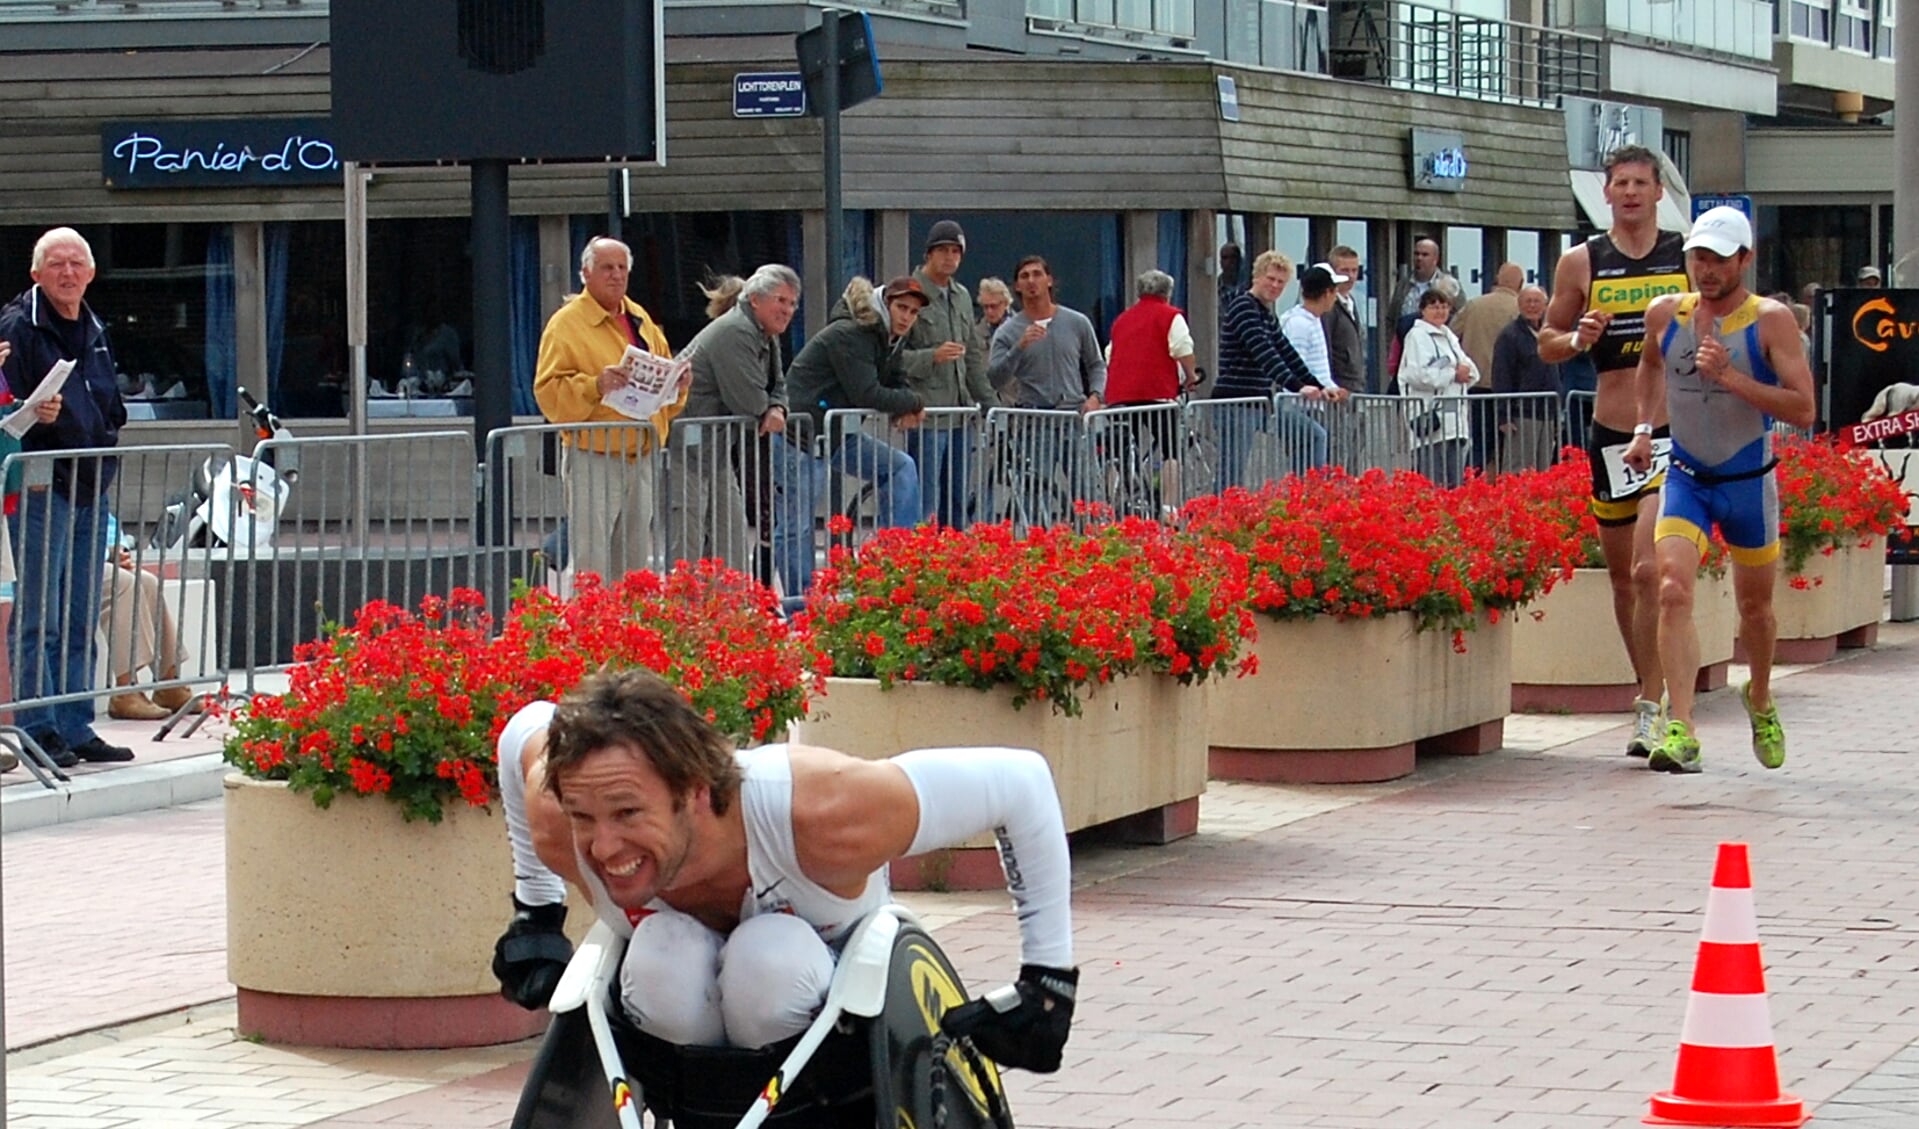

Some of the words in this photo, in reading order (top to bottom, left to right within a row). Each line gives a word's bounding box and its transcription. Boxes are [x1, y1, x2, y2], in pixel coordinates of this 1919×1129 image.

[113, 132, 258, 174] Panier
[1597, 283, 1682, 305] Capino
[1852, 297, 1919, 352] Cav
[1853, 416, 1904, 444] EXTRA
